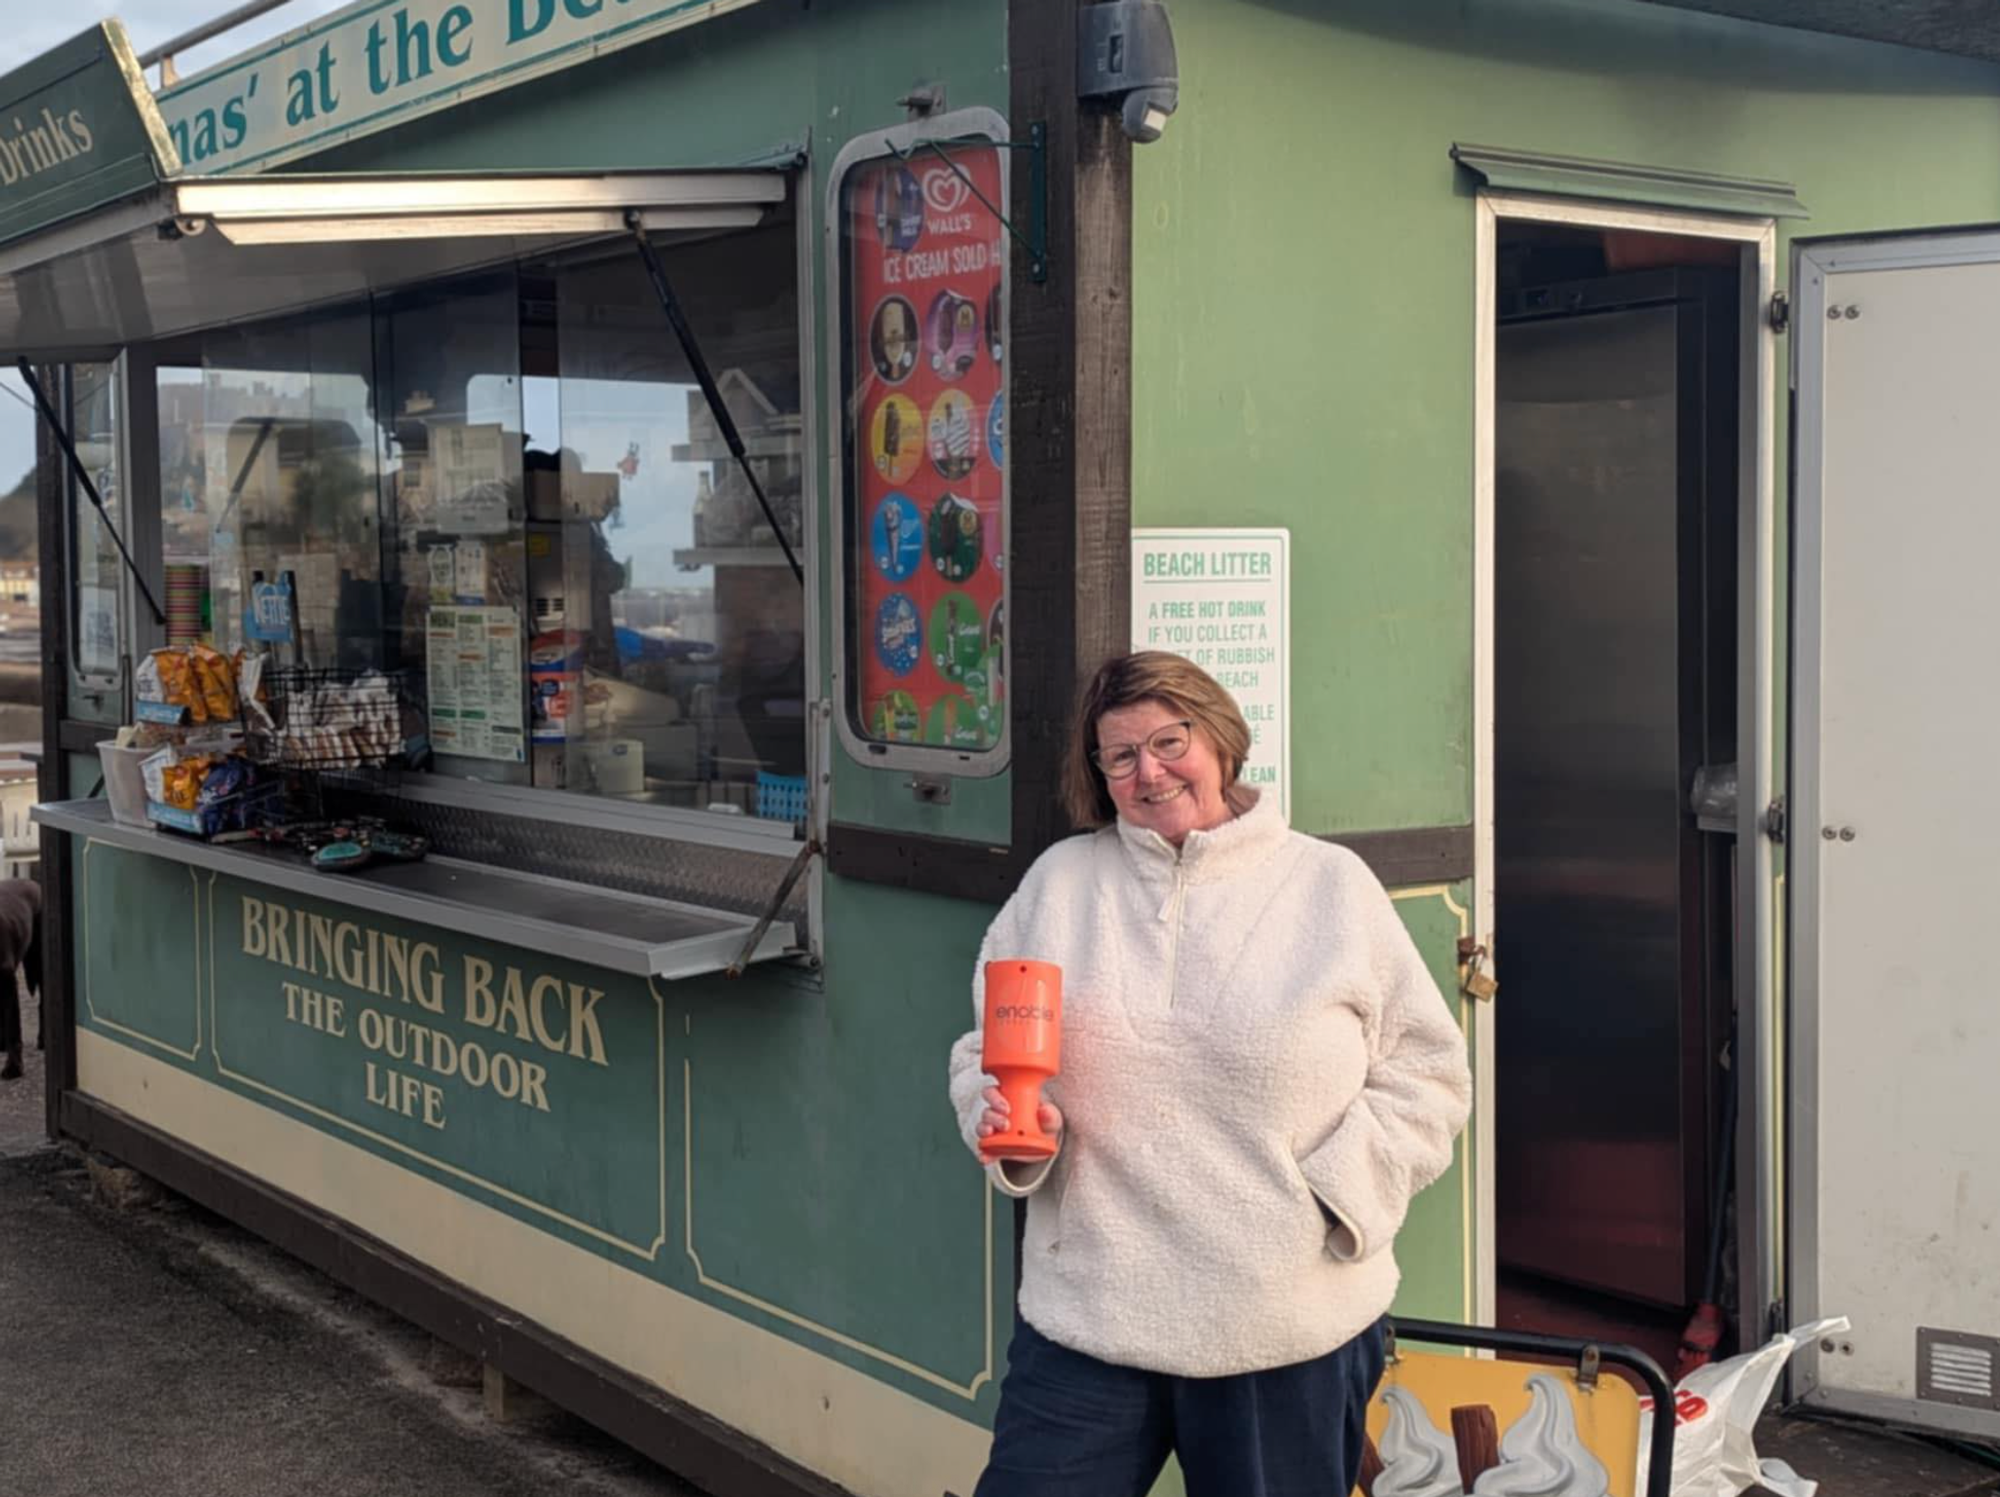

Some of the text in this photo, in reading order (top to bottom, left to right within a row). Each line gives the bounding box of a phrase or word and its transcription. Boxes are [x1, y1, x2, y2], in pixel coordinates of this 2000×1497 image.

[285, 42, 341, 128] at
[363, 10, 473, 96] the
[926, 215, 971, 236] WALL'S
[883, 257, 901, 284] ICE
[906, 251, 950, 282] CREAM
[952, 244, 987, 274] SOLD
[1143, 552, 1272, 577] BEACH LITTER
[1149, 600, 1266, 619] A FREE HOT DRINK
[1148, 624, 1267, 644] IF YOU COLLECT A
[1196, 649, 1214, 667] OF
[1217, 647, 1275, 665] RUBBISH
[242, 896, 609, 1067] BRINGING BACK
[281, 982, 551, 1113] THE OUTDOOR
[365, 1062, 447, 1130] LIFE
